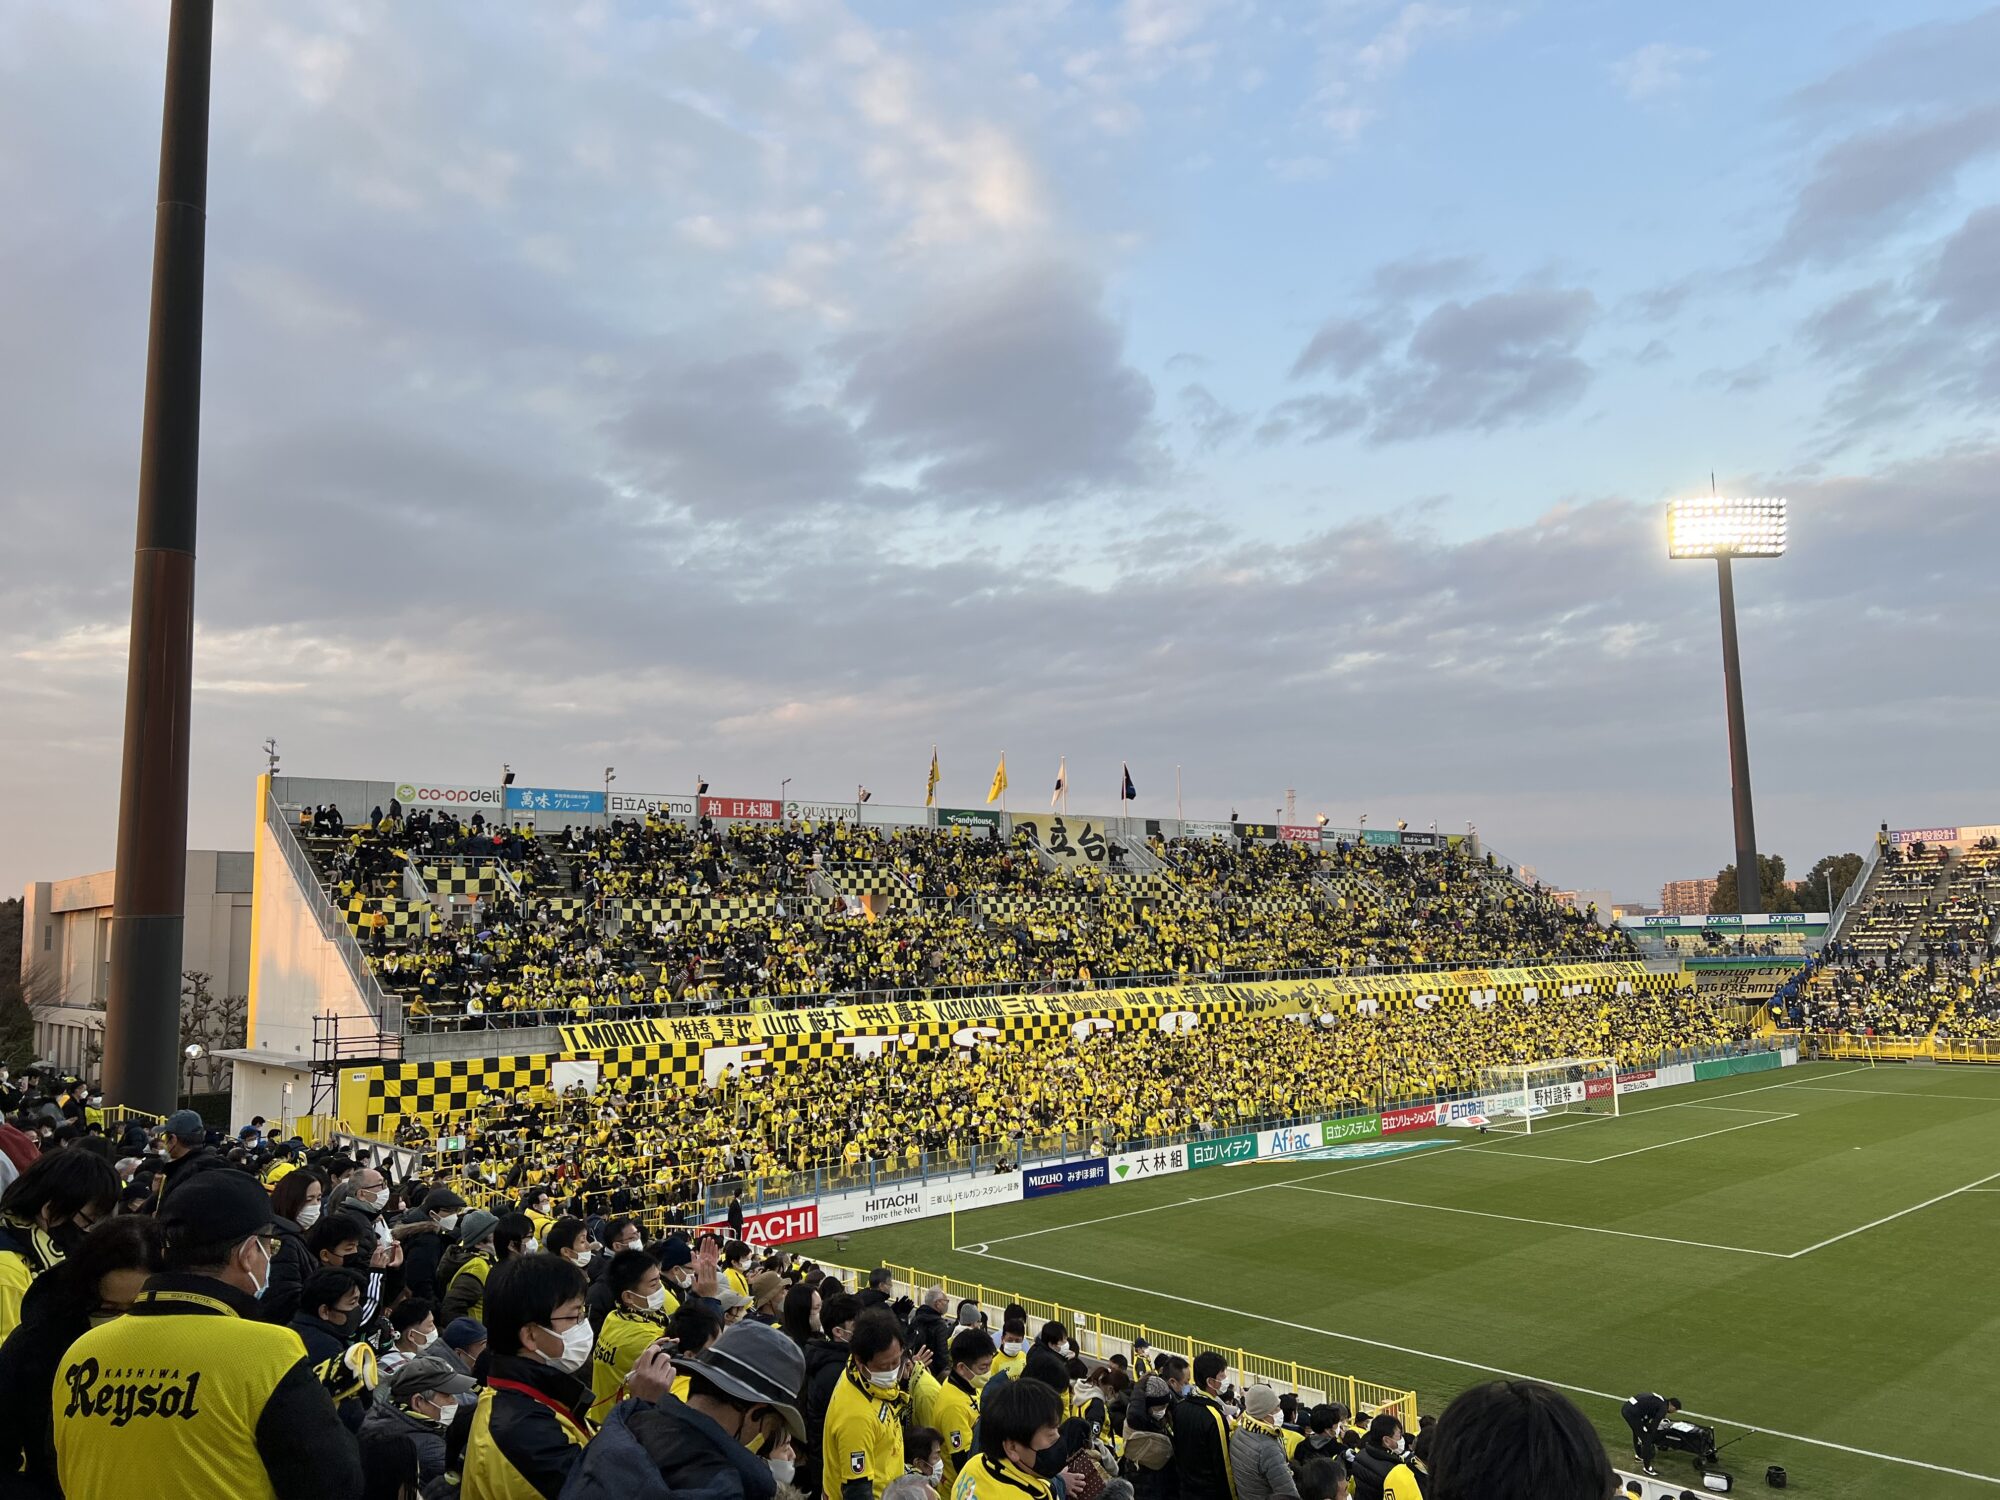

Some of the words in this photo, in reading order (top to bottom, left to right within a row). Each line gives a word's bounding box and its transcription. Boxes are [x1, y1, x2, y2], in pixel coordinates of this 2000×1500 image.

[417, 787, 500, 803] co-opdeli
[520, 790, 550, 808] 萬味
[554, 799, 590, 809] グループ
[708, 801, 721, 816] 柏
[732, 802, 773, 817] 日本閣
[803, 806, 857, 819] QUATTRO
[1658, 917, 1680, 925] YONEX
[1696, 968, 1756, 976] KASHIWA
[1757, 967, 1791, 976] CITY
[1697, 984, 1718, 992] BIG
[857, 1006, 893, 1025] 中村
[933, 999, 1004, 1021] KATAYAMA
[1000, 997, 1044, 1015] 三丸
[762, 1013, 806, 1036] 山本
[806, 1009, 850, 1033] 桜大
[563, 1019, 666, 1050] T.MORITA
[1451, 1100, 1485, 1119] 日立物流
[1326, 1119, 1377, 1140] 日立システムズ
[1382, 1109, 1436, 1131] 日立ソリューションズ
[1271, 1128, 1311, 1154] Aflac
[1193, 1139, 1251, 1164] 日立ハイテク
[1136, 1150, 1183, 1174] 大林組
[1029, 1172, 1063, 1187] MIZUHO
[1067, 1166, 1104, 1183] みずほ銀行
[865, 1192, 918, 1212] HITACHI
[861, 1210, 889, 1223] Inspire
[890, 1208, 902, 1218] the
[903, 1205, 921, 1216] Next
[105, 1368, 180, 1380] KASHIWA
[64, 1357, 201, 1428] Reysol
